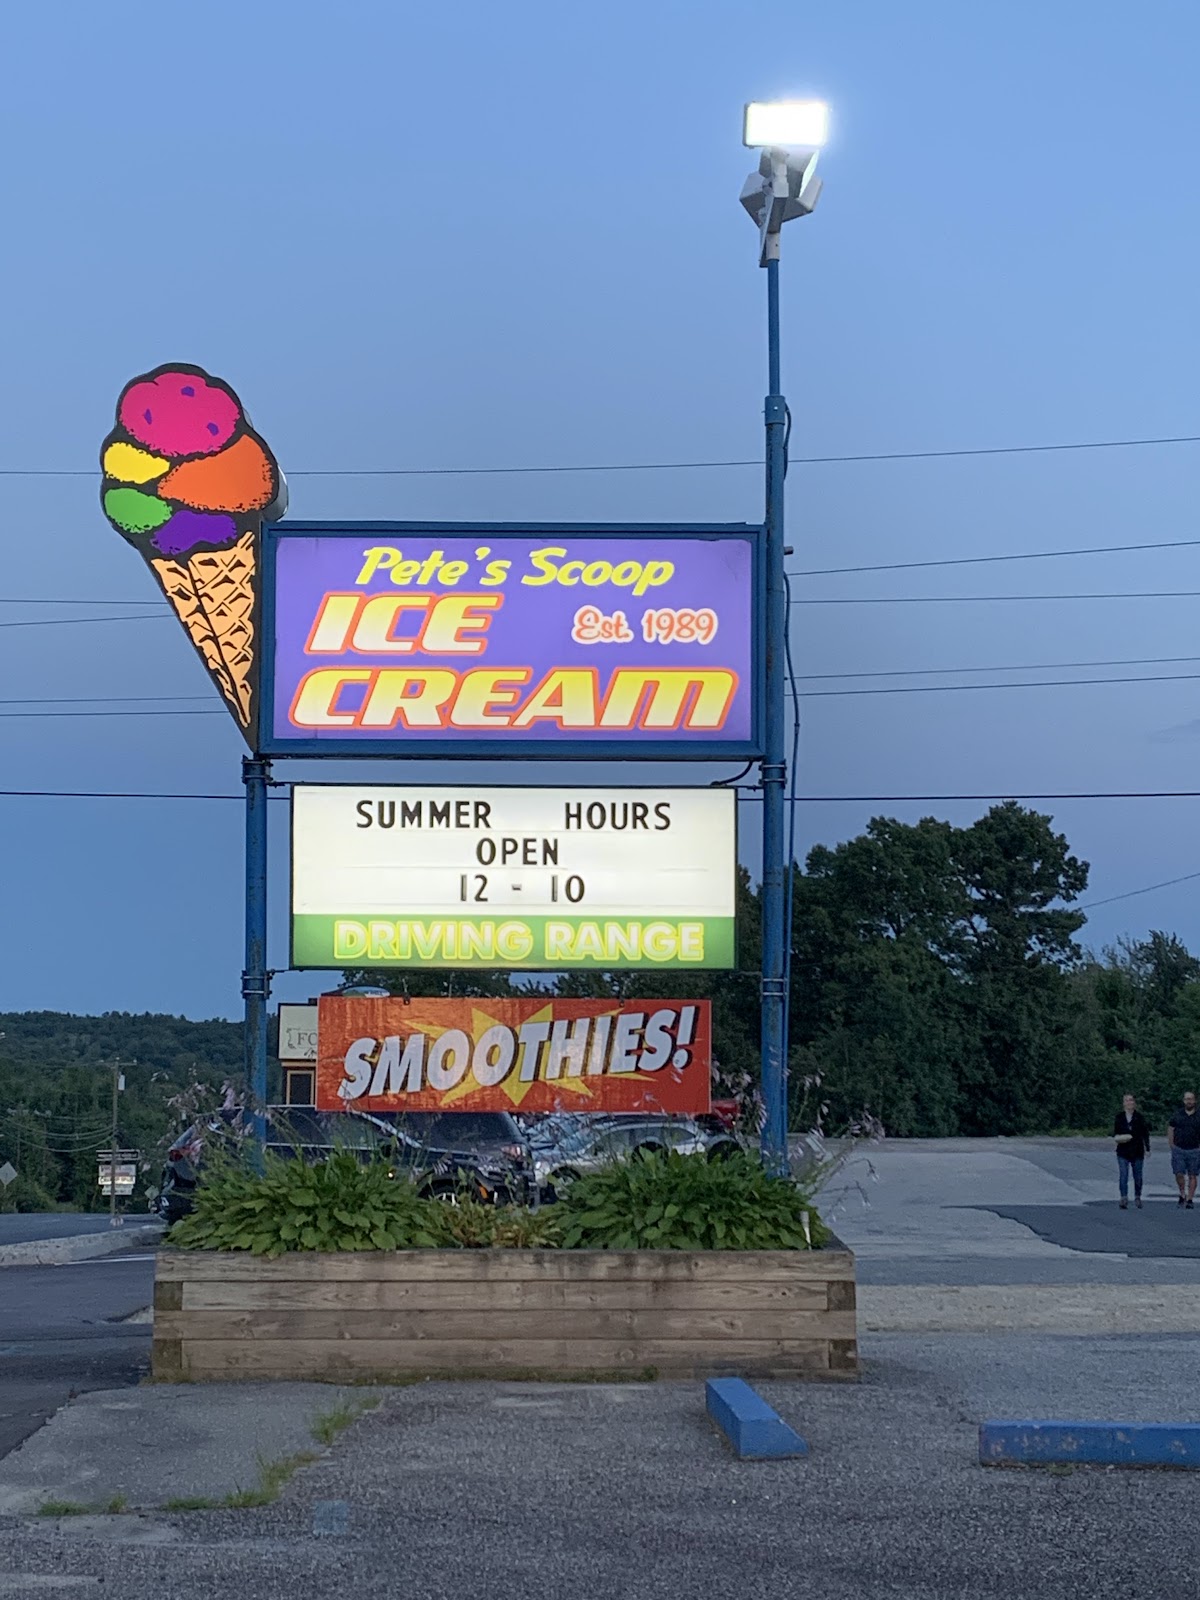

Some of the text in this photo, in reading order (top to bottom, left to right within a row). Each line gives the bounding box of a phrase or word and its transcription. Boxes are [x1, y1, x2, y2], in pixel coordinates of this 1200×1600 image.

[356, 546, 675, 596] Pete's Scoop
[304, 592, 504, 655] ICE
[572, 605, 720, 646] Est. 1989
[288, 666, 740, 732] CREAM
[356, 800, 671, 831] SUMMER HOURS
[476, 838, 559, 866] OPEN
[460, 874, 489, 902] 12
[551, 874, 585, 902] 10
[333, 920, 705, 963] DRIVING RANGE
[337, 1004, 699, 1101] SMOOTHIES!
